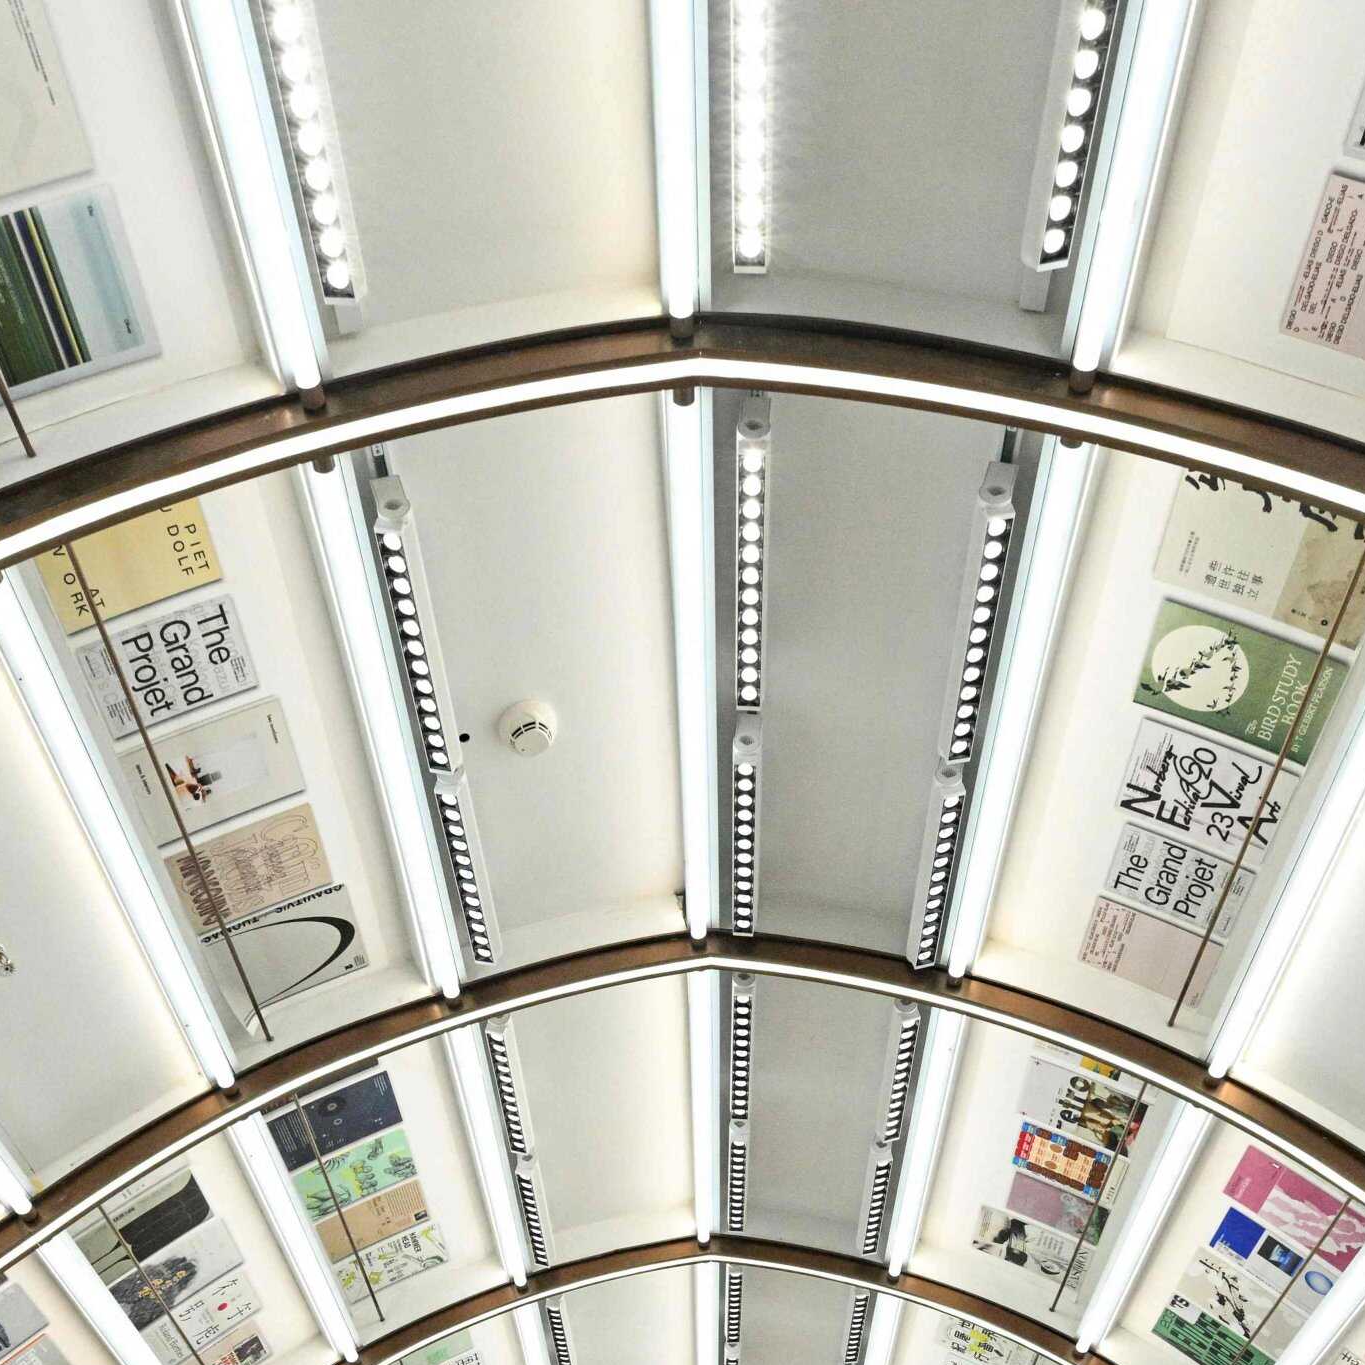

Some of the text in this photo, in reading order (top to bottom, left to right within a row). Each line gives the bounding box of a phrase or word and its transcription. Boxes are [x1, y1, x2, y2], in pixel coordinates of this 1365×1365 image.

[159, 618, 213, 708] Grand
[196, 604, 233, 668] The
[120, 630, 175, 718] Projet
[1257, 652, 1301, 744] BIRD STUDY
[1205, 813, 1235, 844] 23
[1113, 852, 1149, 895] The
[1144, 840, 1189, 907] Grand
[1174, 857, 1219, 920] Projet
